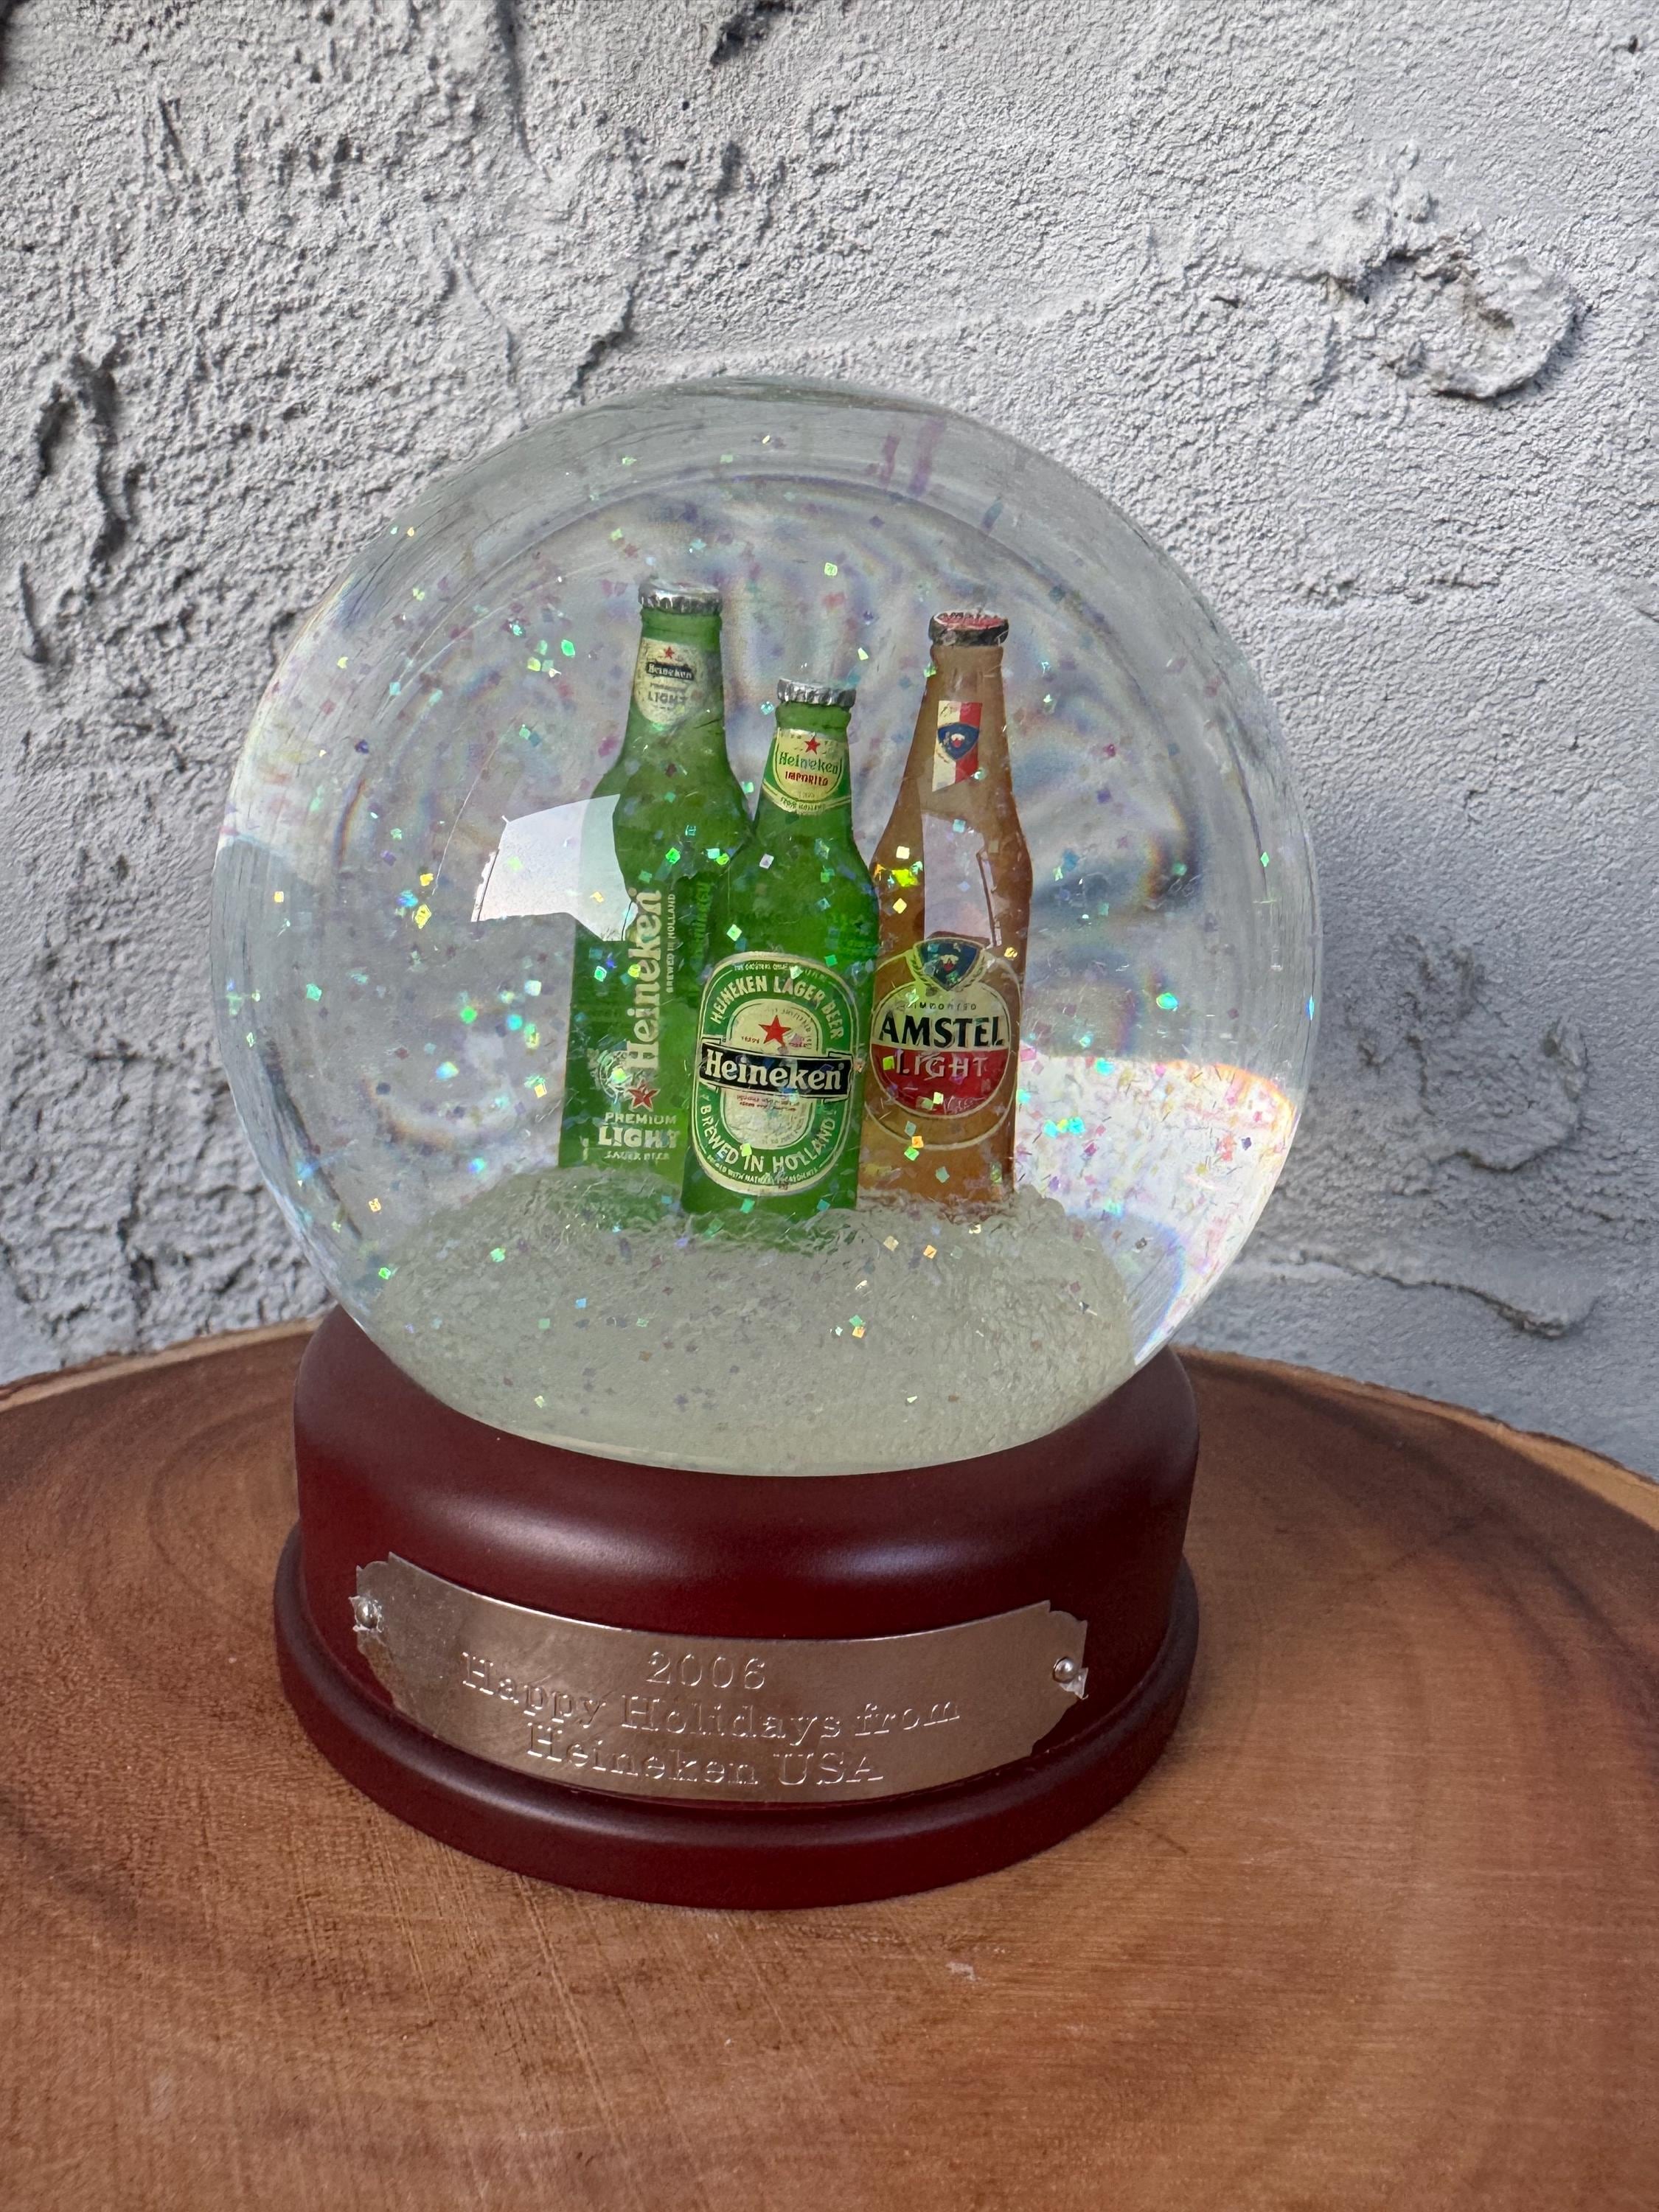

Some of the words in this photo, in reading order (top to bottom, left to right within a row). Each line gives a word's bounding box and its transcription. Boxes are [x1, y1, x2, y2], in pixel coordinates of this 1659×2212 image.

[779, 751, 839, 776] Heineken
[667, 894, 676, 939] HOLLAND
[627, 888, 662, 1071] Heineken
[710, 975, 768, 1024] HEINEKEN
[773, 975, 825, 1010] LAGER
[821, 999, 844, 1040] BEER
[879, 1014, 1004, 1048] AMSTEL
[705, 1049, 841, 1091] Heineken
[896, 1048, 988, 1078] LIGHT
[598, 1125, 680, 1148] LIGHT
[604, 1112, 677, 1124] PREMIUM
[700, 1105, 739, 1164] BREWED
[743, 1155, 765, 1172] IN
[773, 1119, 836, 1173] HOLLAND
[646, 1650, 765, 1690] 2006
[462, 1652, 607, 1729] Happy
[621, 1694, 840, 1746] Holidays
[855, 1702, 960, 1736] from
[527, 1722, 759, 1785] Heineken
[773, 1751, 884, 1786] USA
